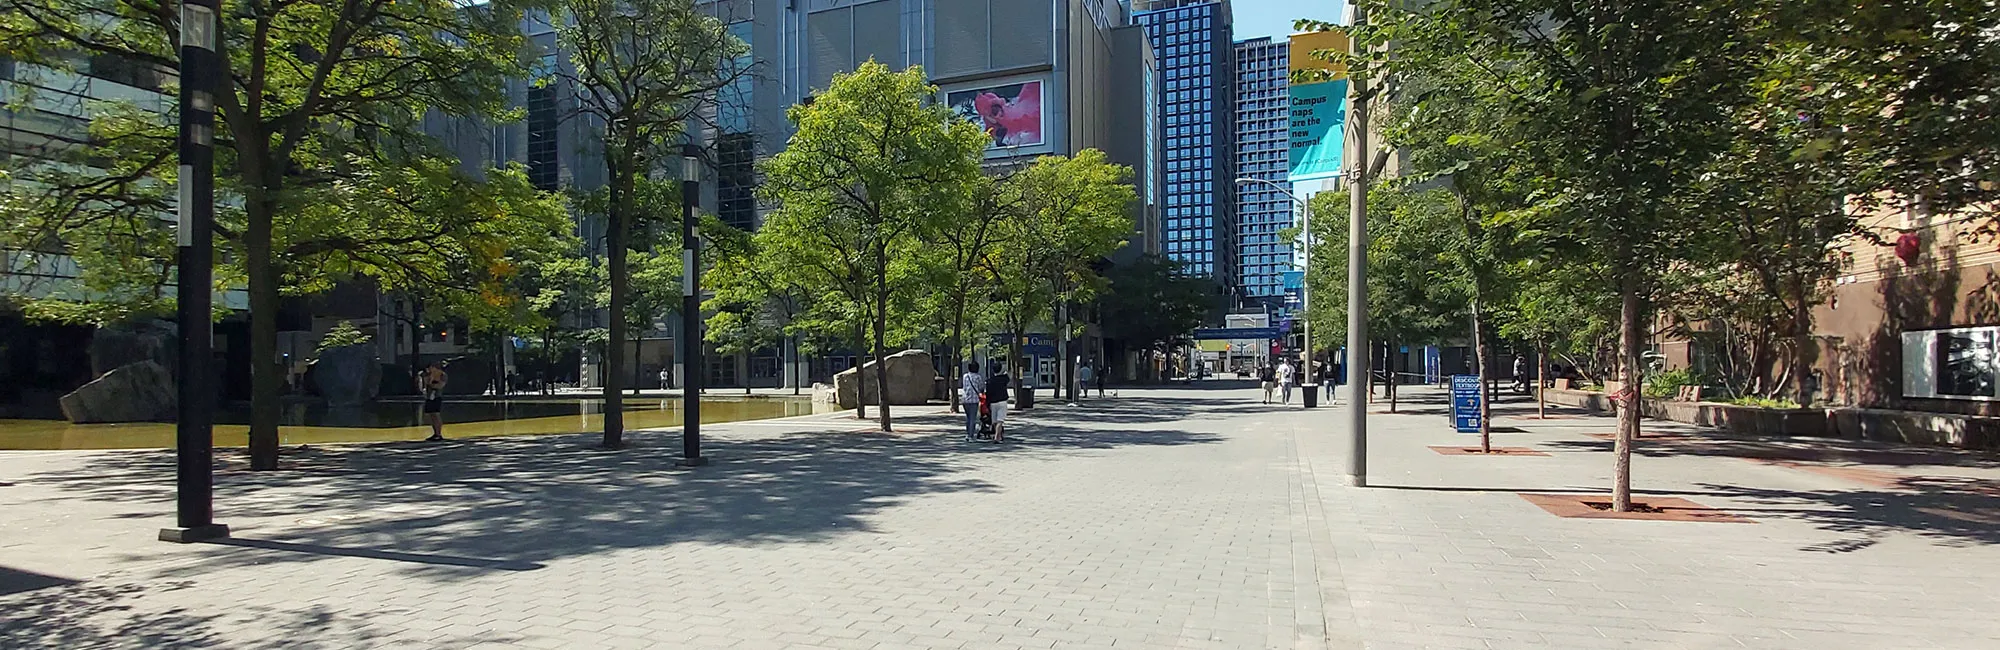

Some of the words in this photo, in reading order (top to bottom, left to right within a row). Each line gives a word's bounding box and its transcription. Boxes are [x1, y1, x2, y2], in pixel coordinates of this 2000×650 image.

[1292, 95, 1327, 106] Campus
[1292, 108, 1313, 118] naps
[1308, 117, 1320, 126] the
[1292, 130, 1309, 138] new
[1292, 136, 1323, 148] normal.
